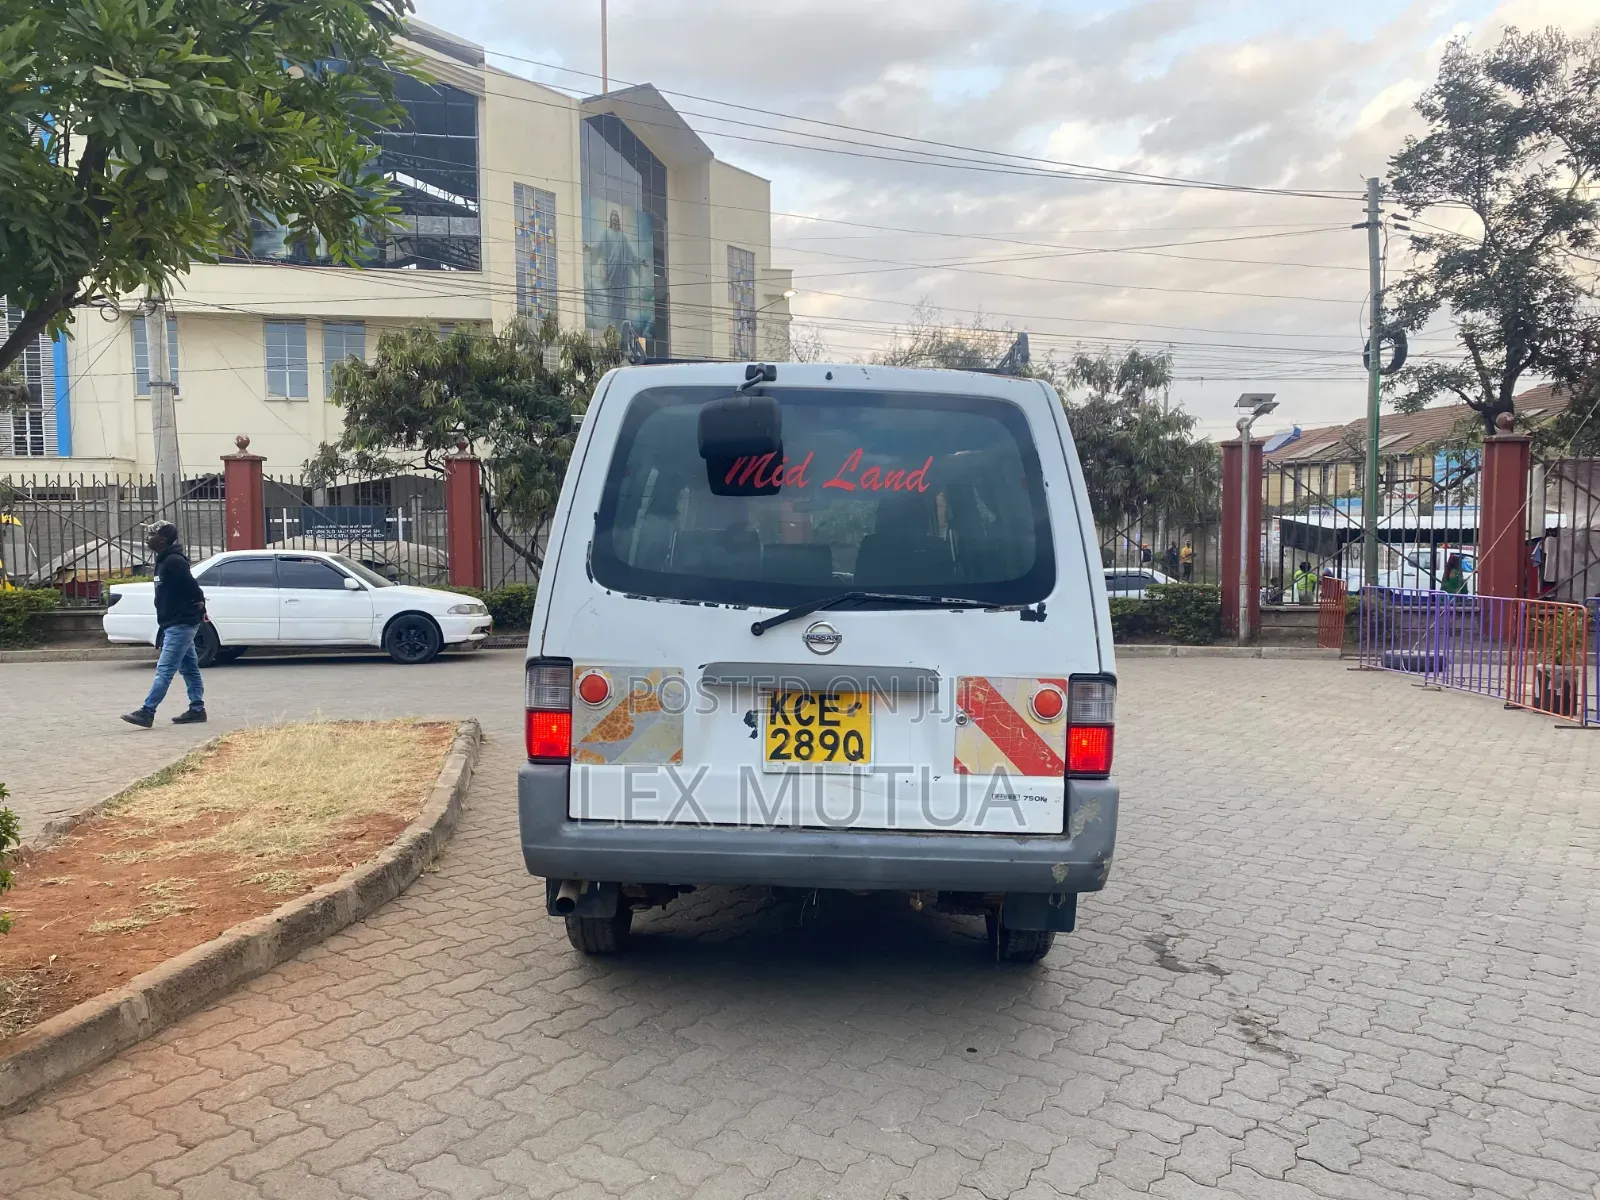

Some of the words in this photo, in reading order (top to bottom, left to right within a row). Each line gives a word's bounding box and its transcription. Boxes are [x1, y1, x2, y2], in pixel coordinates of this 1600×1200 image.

[724, 450, 814, 489] Mid
[823, 447, 933, 493] Land
[769, 691, 841, 727] KCE
[769, 728, 865, 762] 289Q
